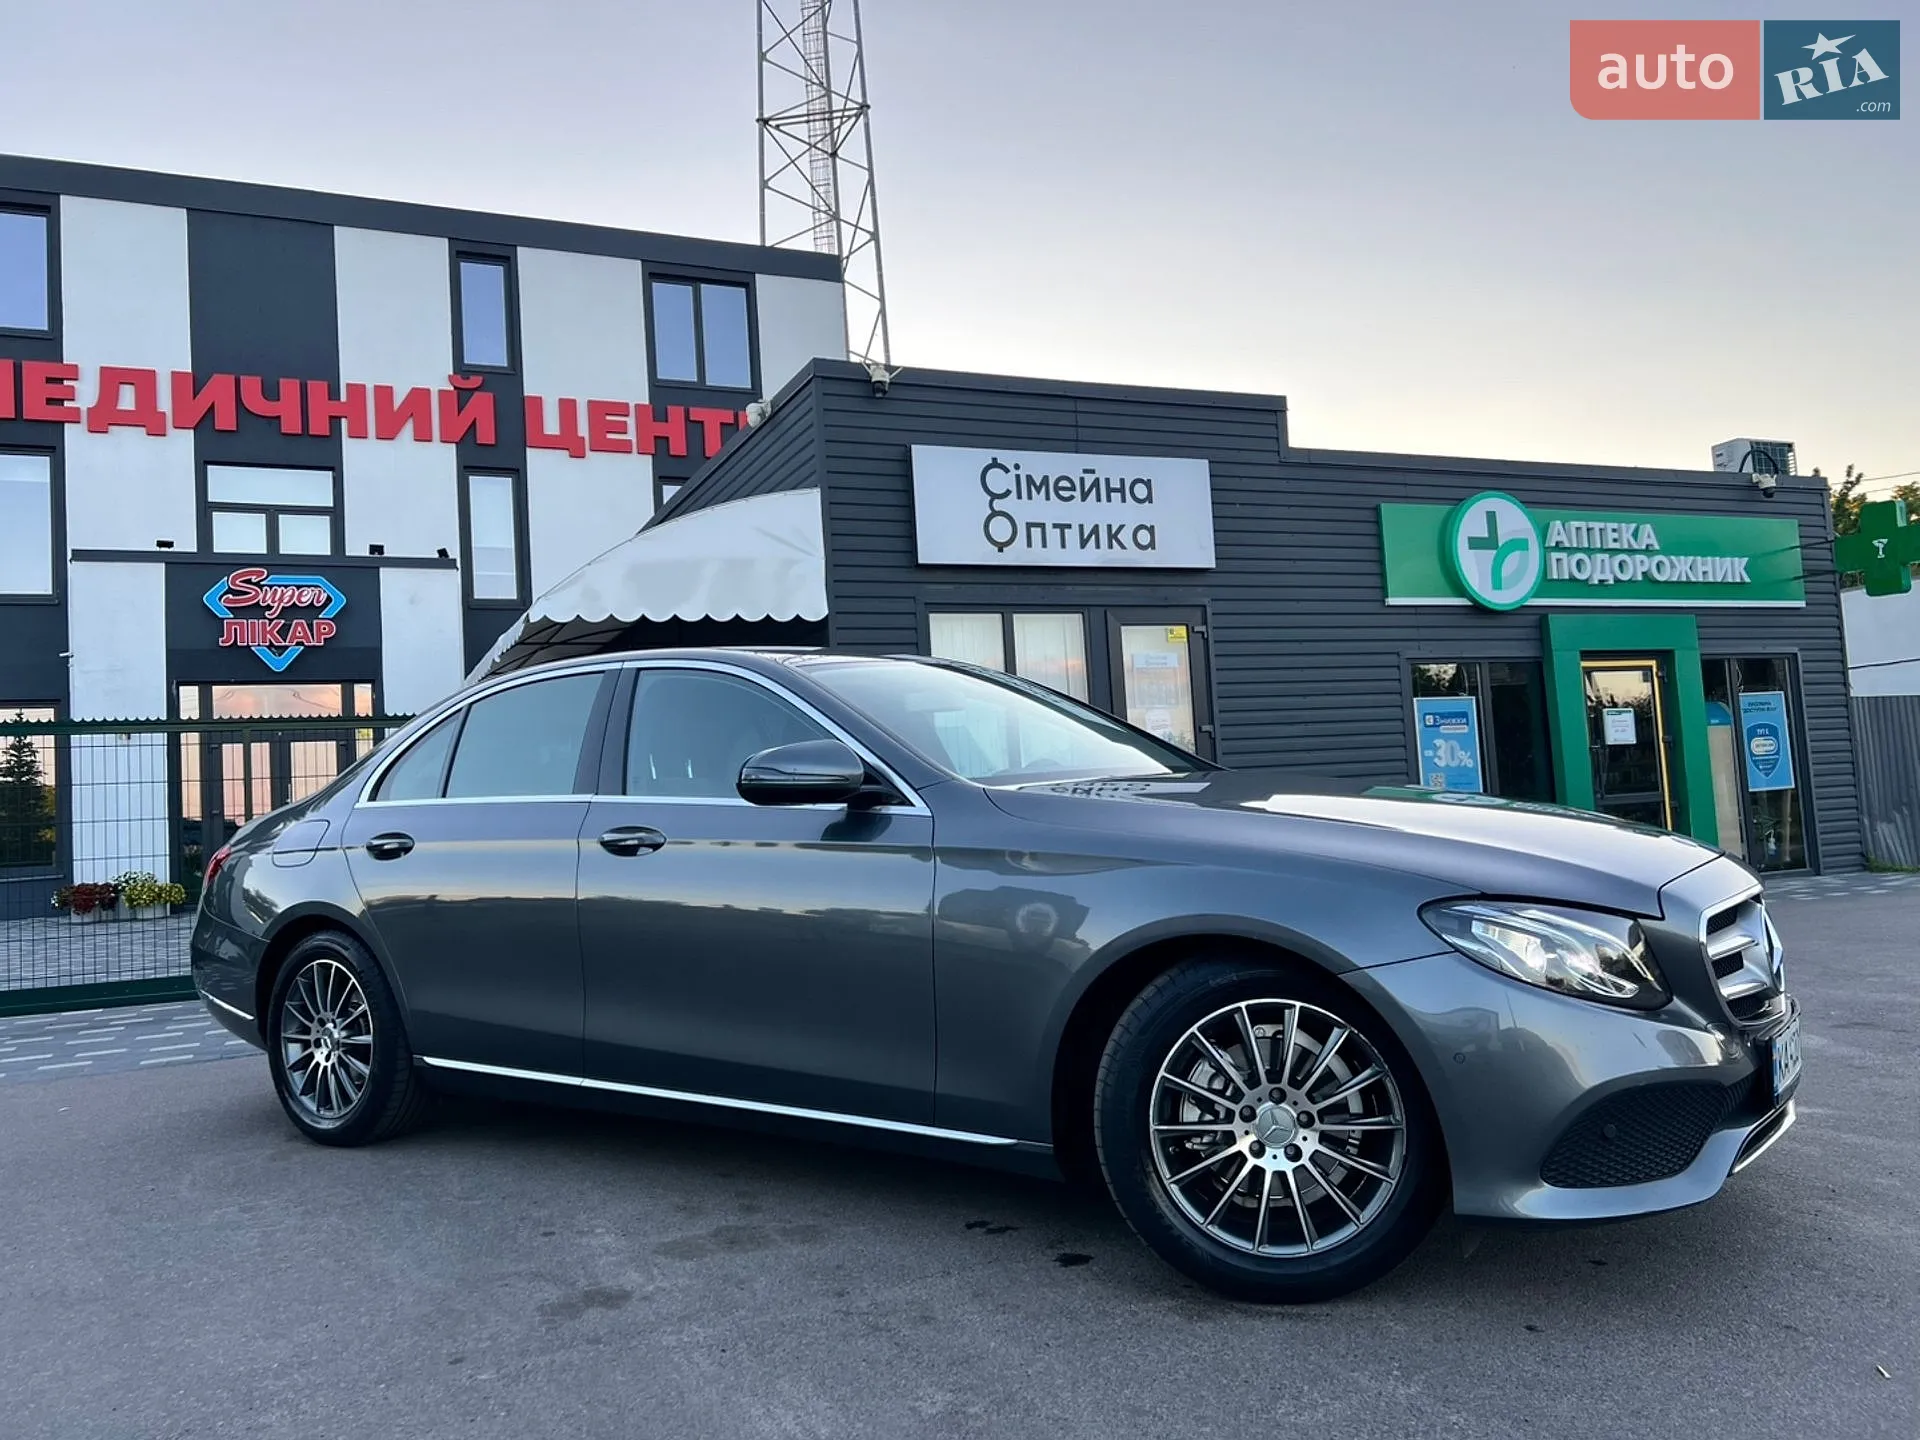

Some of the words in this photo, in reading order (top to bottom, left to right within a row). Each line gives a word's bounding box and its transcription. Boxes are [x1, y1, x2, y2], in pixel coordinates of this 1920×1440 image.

[524, 395, 748, 459] ЦЕНТ
[980, 457, 1153, 504] Сімейна
[983, 510, 1157, 553] Оптика
[1545, 520, 1660, 550] АПТЕКА
[1546, 552, 1751, 584] ПОДОРОЖНИК
[221, 568, 327, 618] Super
[219, 619, 336, 647] ЛІКАР
